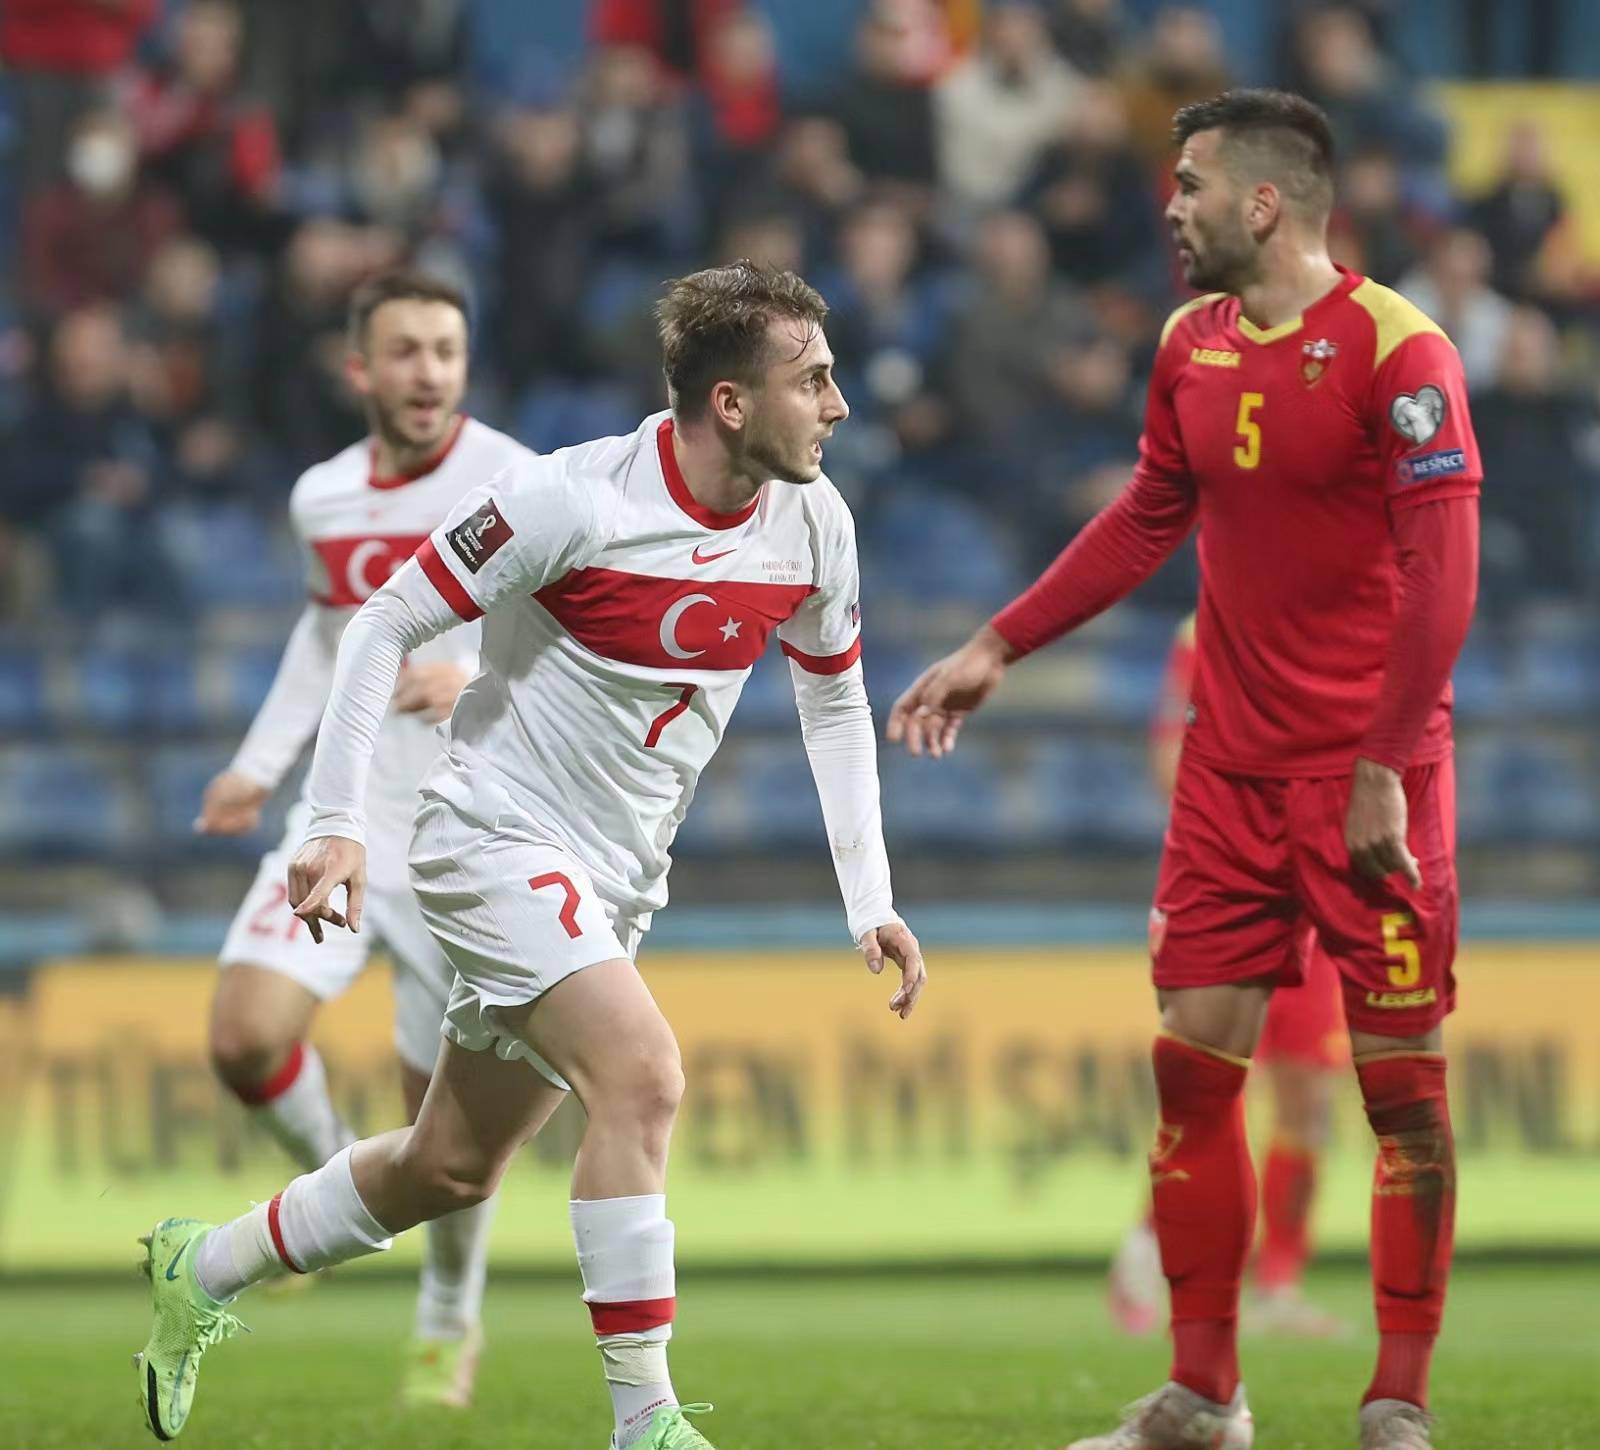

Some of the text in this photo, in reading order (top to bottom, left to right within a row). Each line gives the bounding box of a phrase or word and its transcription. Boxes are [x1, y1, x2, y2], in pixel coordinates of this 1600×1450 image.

[1234, 391, 1265, 469] 5
[1413, 453, 1464, 475] RESPECT
[644, 685, 698, 748] 7
[528, 871, 583, 939] 7
[1381, 912, 1420, 986] 5
